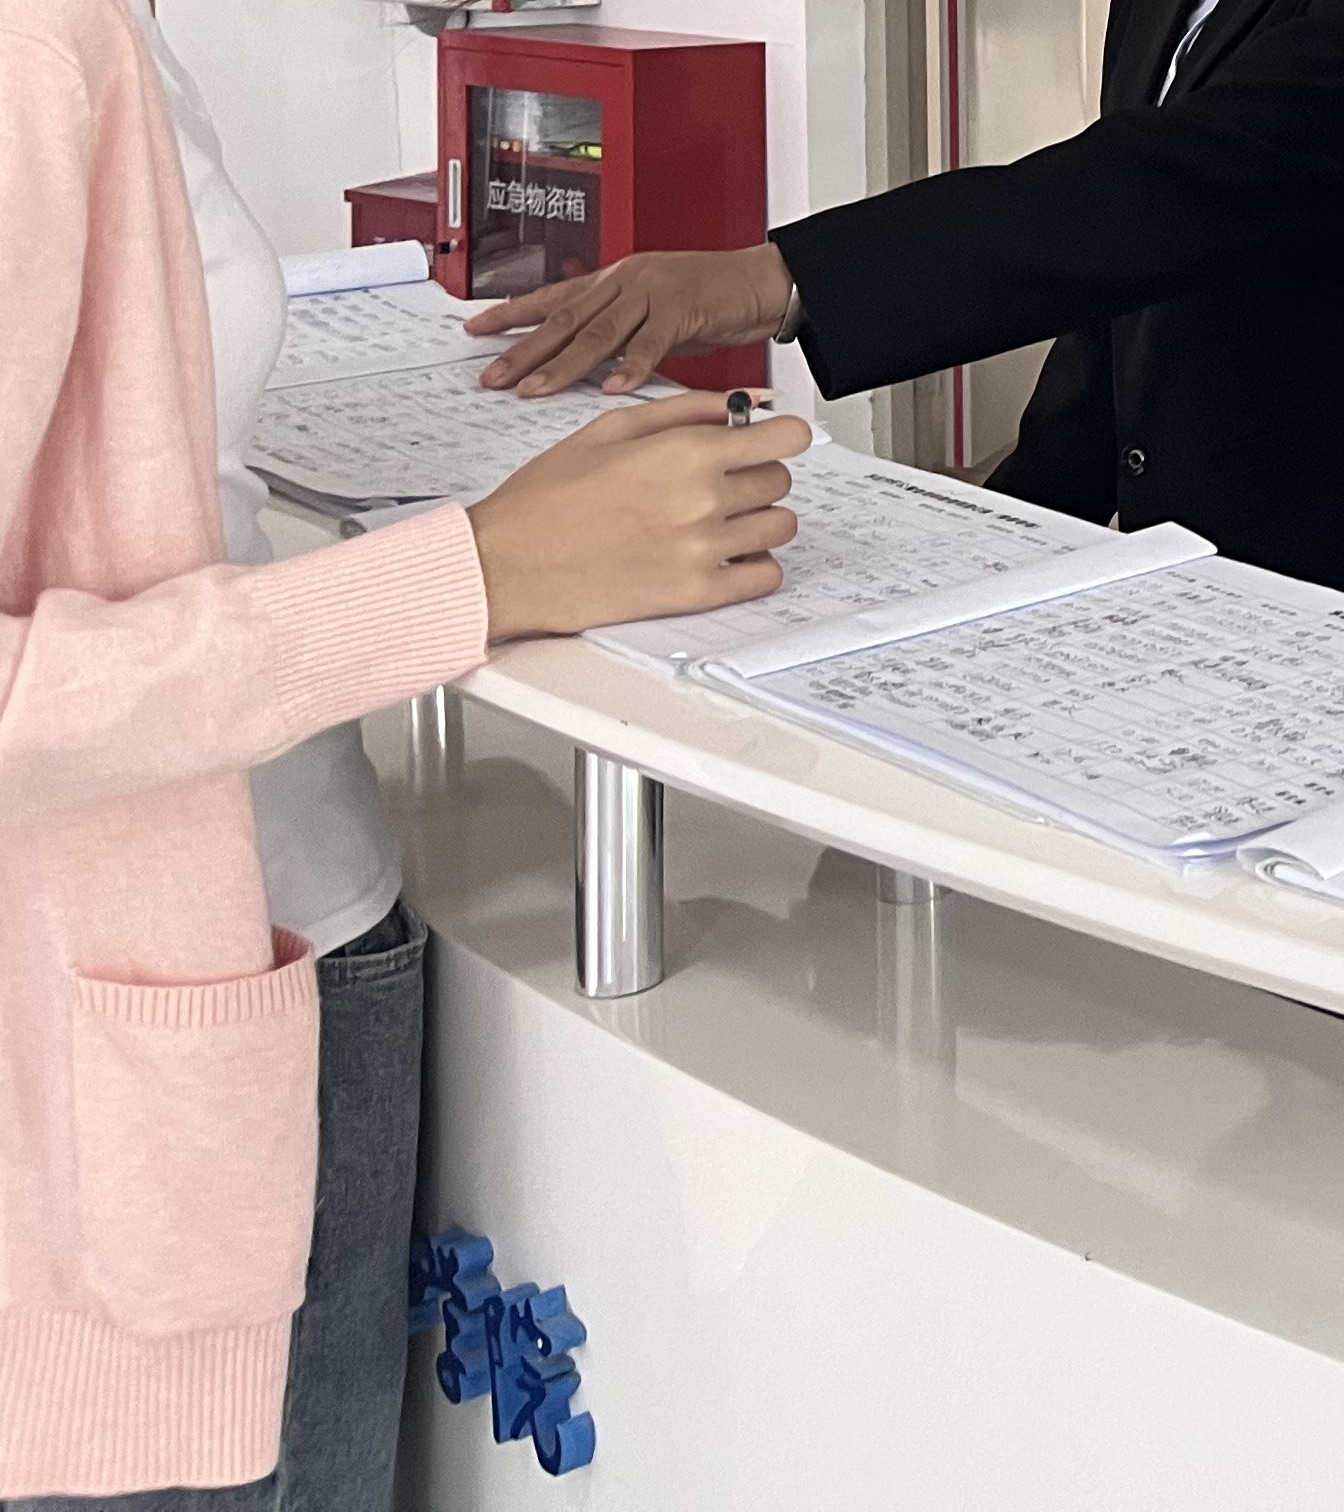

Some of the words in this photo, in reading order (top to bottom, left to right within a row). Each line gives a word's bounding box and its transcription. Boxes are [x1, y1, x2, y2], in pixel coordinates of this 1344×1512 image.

[487, 178, 585, 223] 应急物资箱
